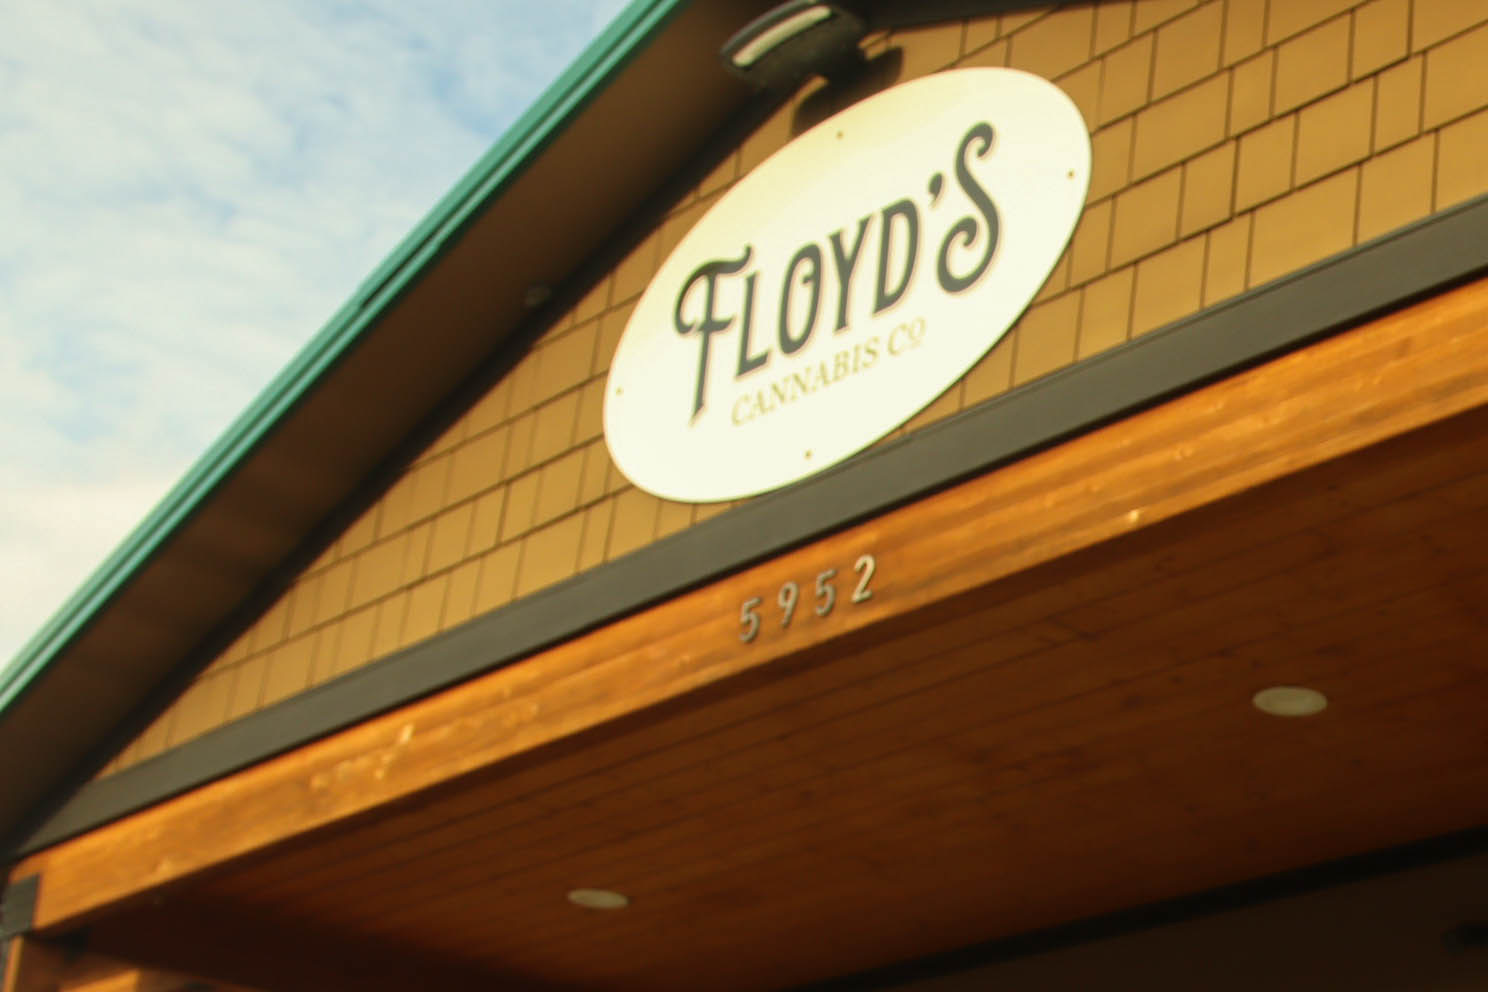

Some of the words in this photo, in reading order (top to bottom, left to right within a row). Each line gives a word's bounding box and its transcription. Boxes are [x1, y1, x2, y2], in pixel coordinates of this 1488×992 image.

[673, 120, 1000, 427] FLOYD'S
[731, 336, 881, 427] CANNABIS
[738, 554, 877, 643] 5952
